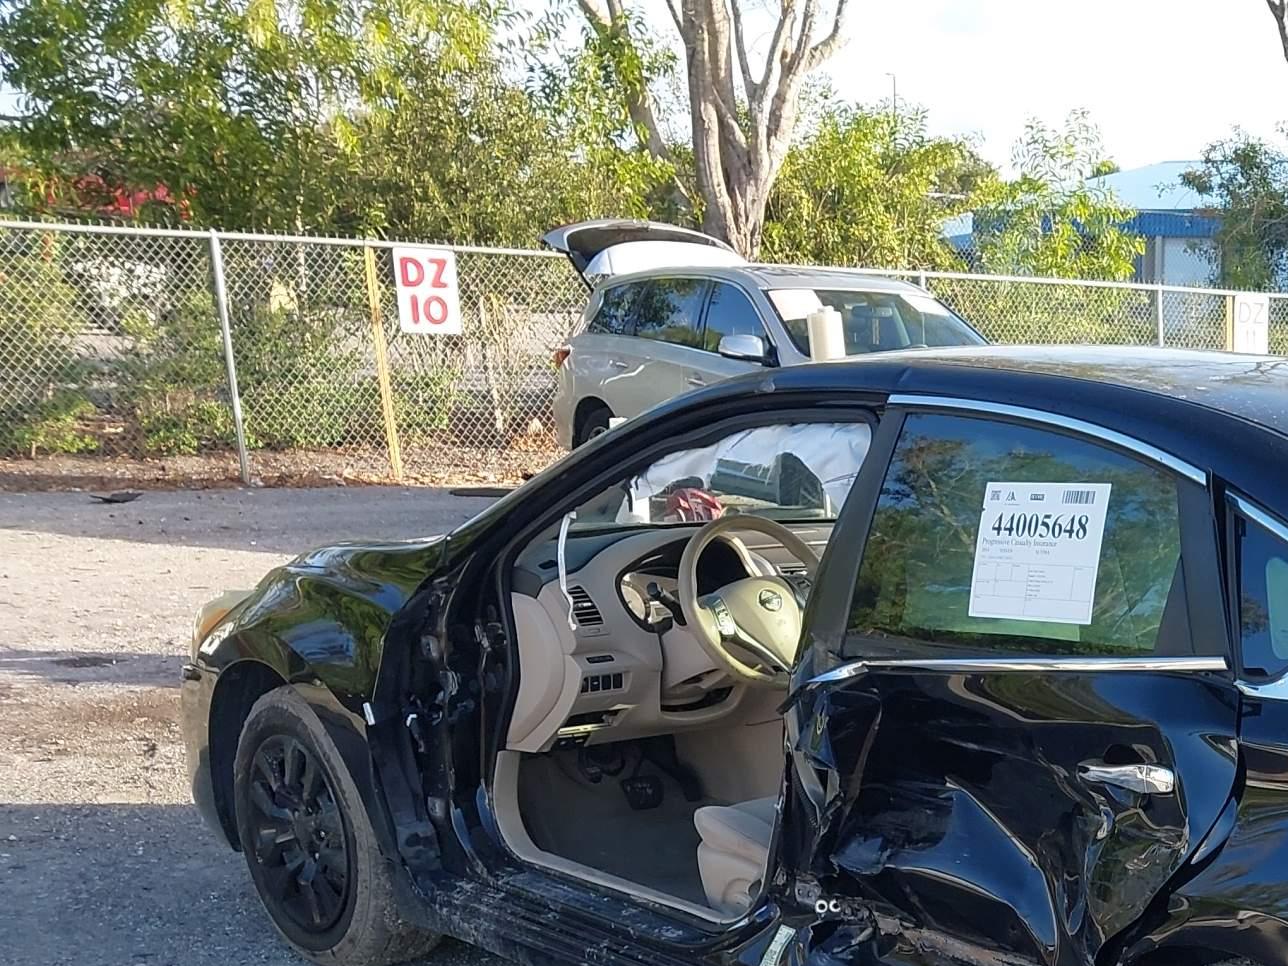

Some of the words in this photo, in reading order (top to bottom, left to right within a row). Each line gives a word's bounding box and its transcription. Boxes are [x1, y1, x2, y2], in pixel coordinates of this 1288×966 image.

[399, 257, 448, 289] DZ
[1239, 302, 1265, 324] DZ
[991, 512, 1090, 540] 44005648
